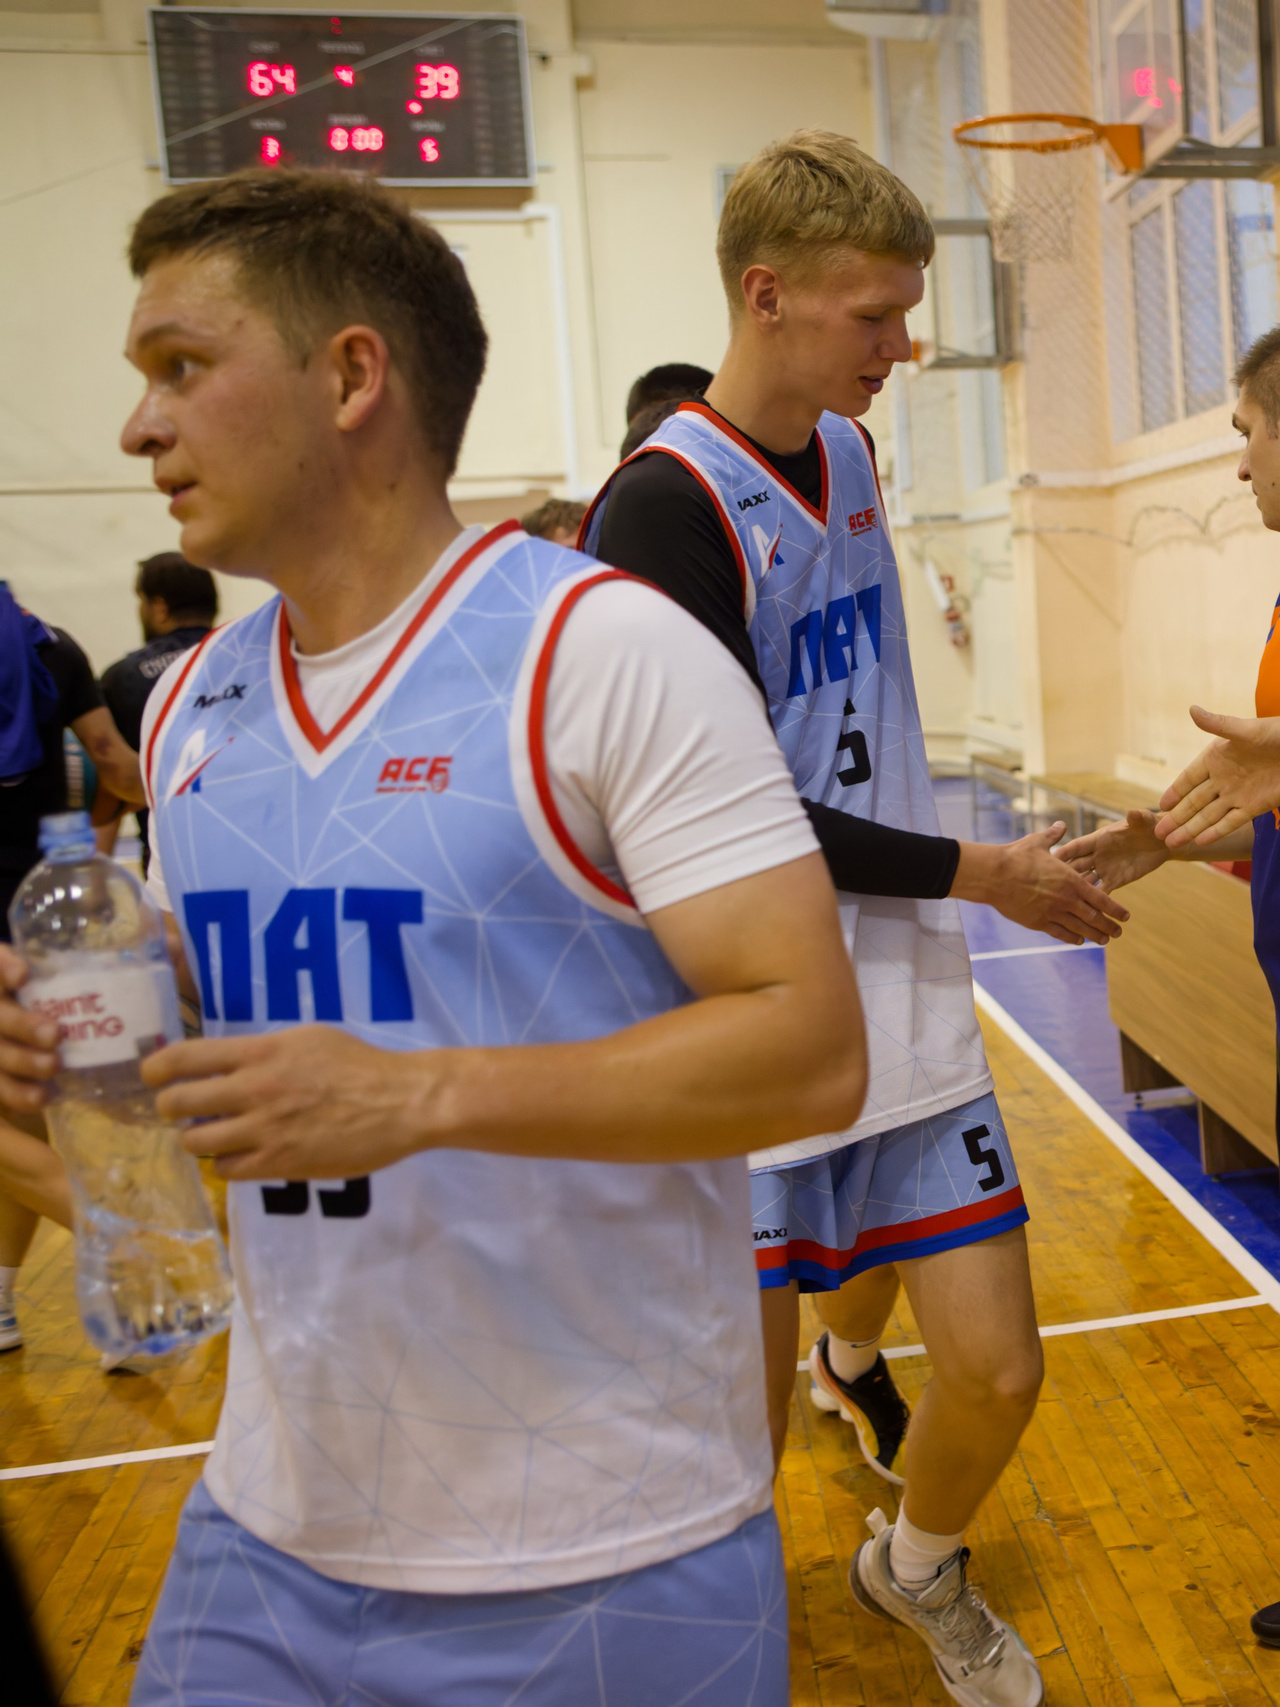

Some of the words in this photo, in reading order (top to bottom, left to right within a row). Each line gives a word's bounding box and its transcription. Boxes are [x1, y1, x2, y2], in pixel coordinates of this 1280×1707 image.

[248, 61, 296, 97] 64
[414, 63, 460, 99] 39
[786, 584, 882, 698] ПАТ
[182, 887, 423, 1024] ПАТ
[961, 1124, 1005, 1192] 5
